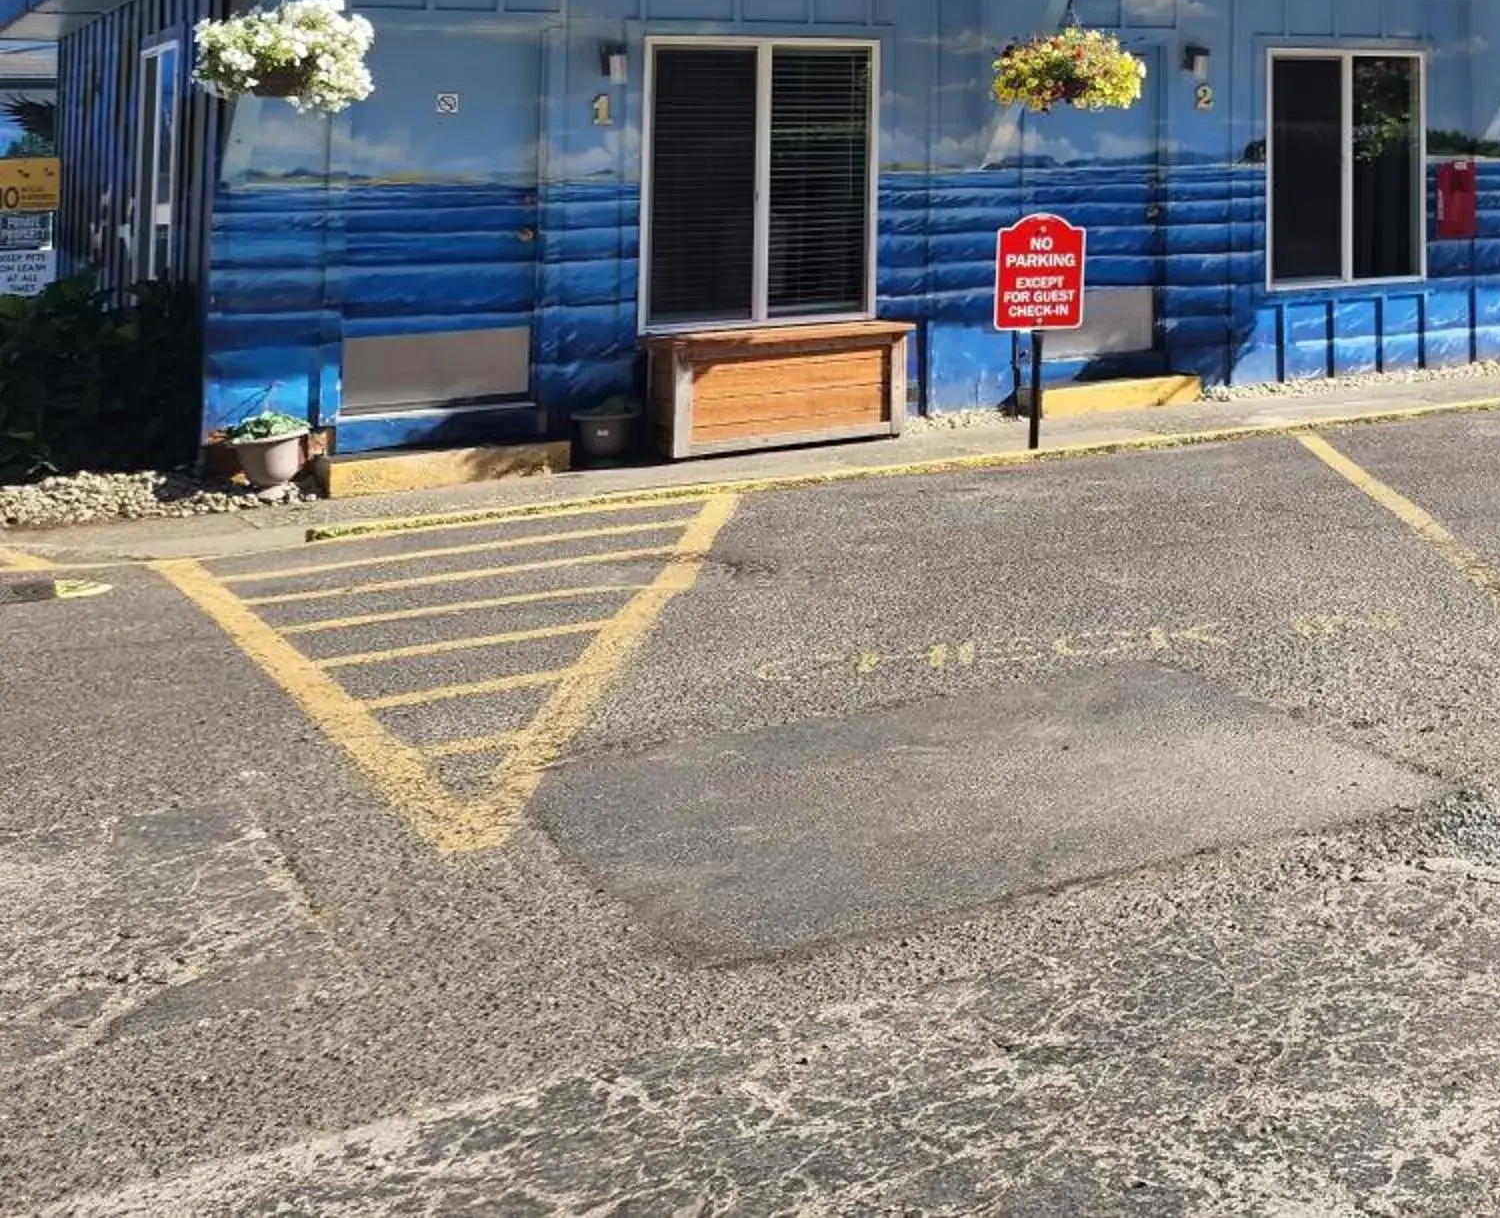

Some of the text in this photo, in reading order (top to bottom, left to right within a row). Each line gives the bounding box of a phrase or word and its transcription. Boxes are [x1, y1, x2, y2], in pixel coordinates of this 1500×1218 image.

[1196, 84, 1214, 110] 2
[592, 94, 614, 126] 1
[1029, 237, 1053, 251] NO
[1005, 253, 1076, 268] PARKING
[1015, 276, 1064, 289] EXCEPT
[1003, 290, 1075, 302] FOR GUEST
[1008, 304, 1069, 317] CHECK-IN
